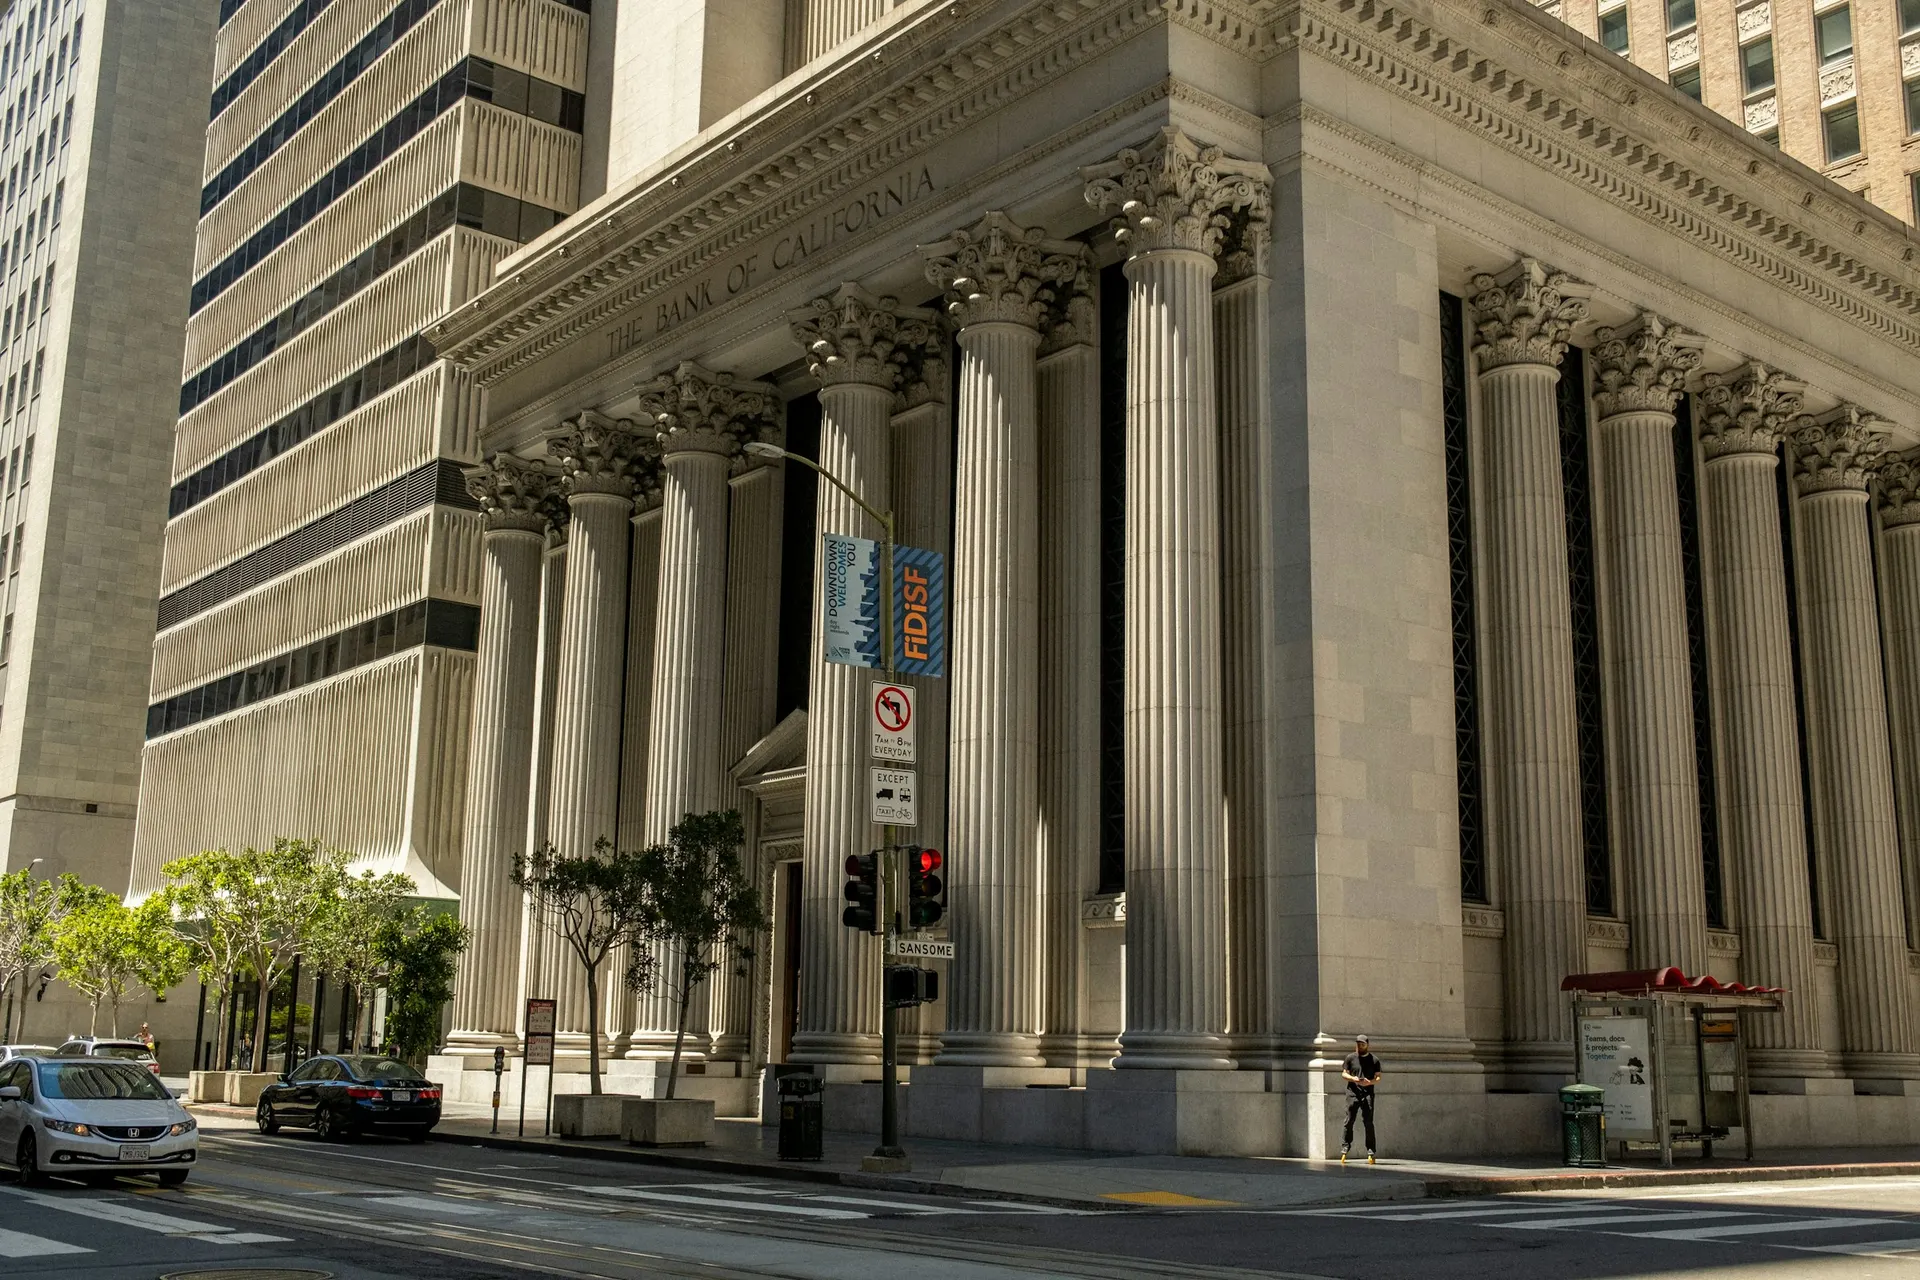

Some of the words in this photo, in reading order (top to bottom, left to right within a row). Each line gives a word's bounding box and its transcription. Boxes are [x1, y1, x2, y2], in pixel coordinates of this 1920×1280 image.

[606, 316, 643, 359] THE
[656, 278, 713, 332] BANK
[727, 254, 758, 294] OF
[771, 166, 935, 270] CALIFORNIA
[847, 543, 856, 567] YOU
[828, 540, 838, 617] DOWNTOWN
[838, 541, 847, 607] WELCOMES
[903, 566, 928, 660] FiDiSF
[874, 745, 912, 757] EVERYDAY
[877, 773, 909, 784] EXCEPT
[899, 942, 953, 956] SANSOME
[1585, 1035, 1609, 1043] Teams,
[1591, 1044, 1620, 1052] projects.
[1586, 1053, 1617, 1061] Together.
